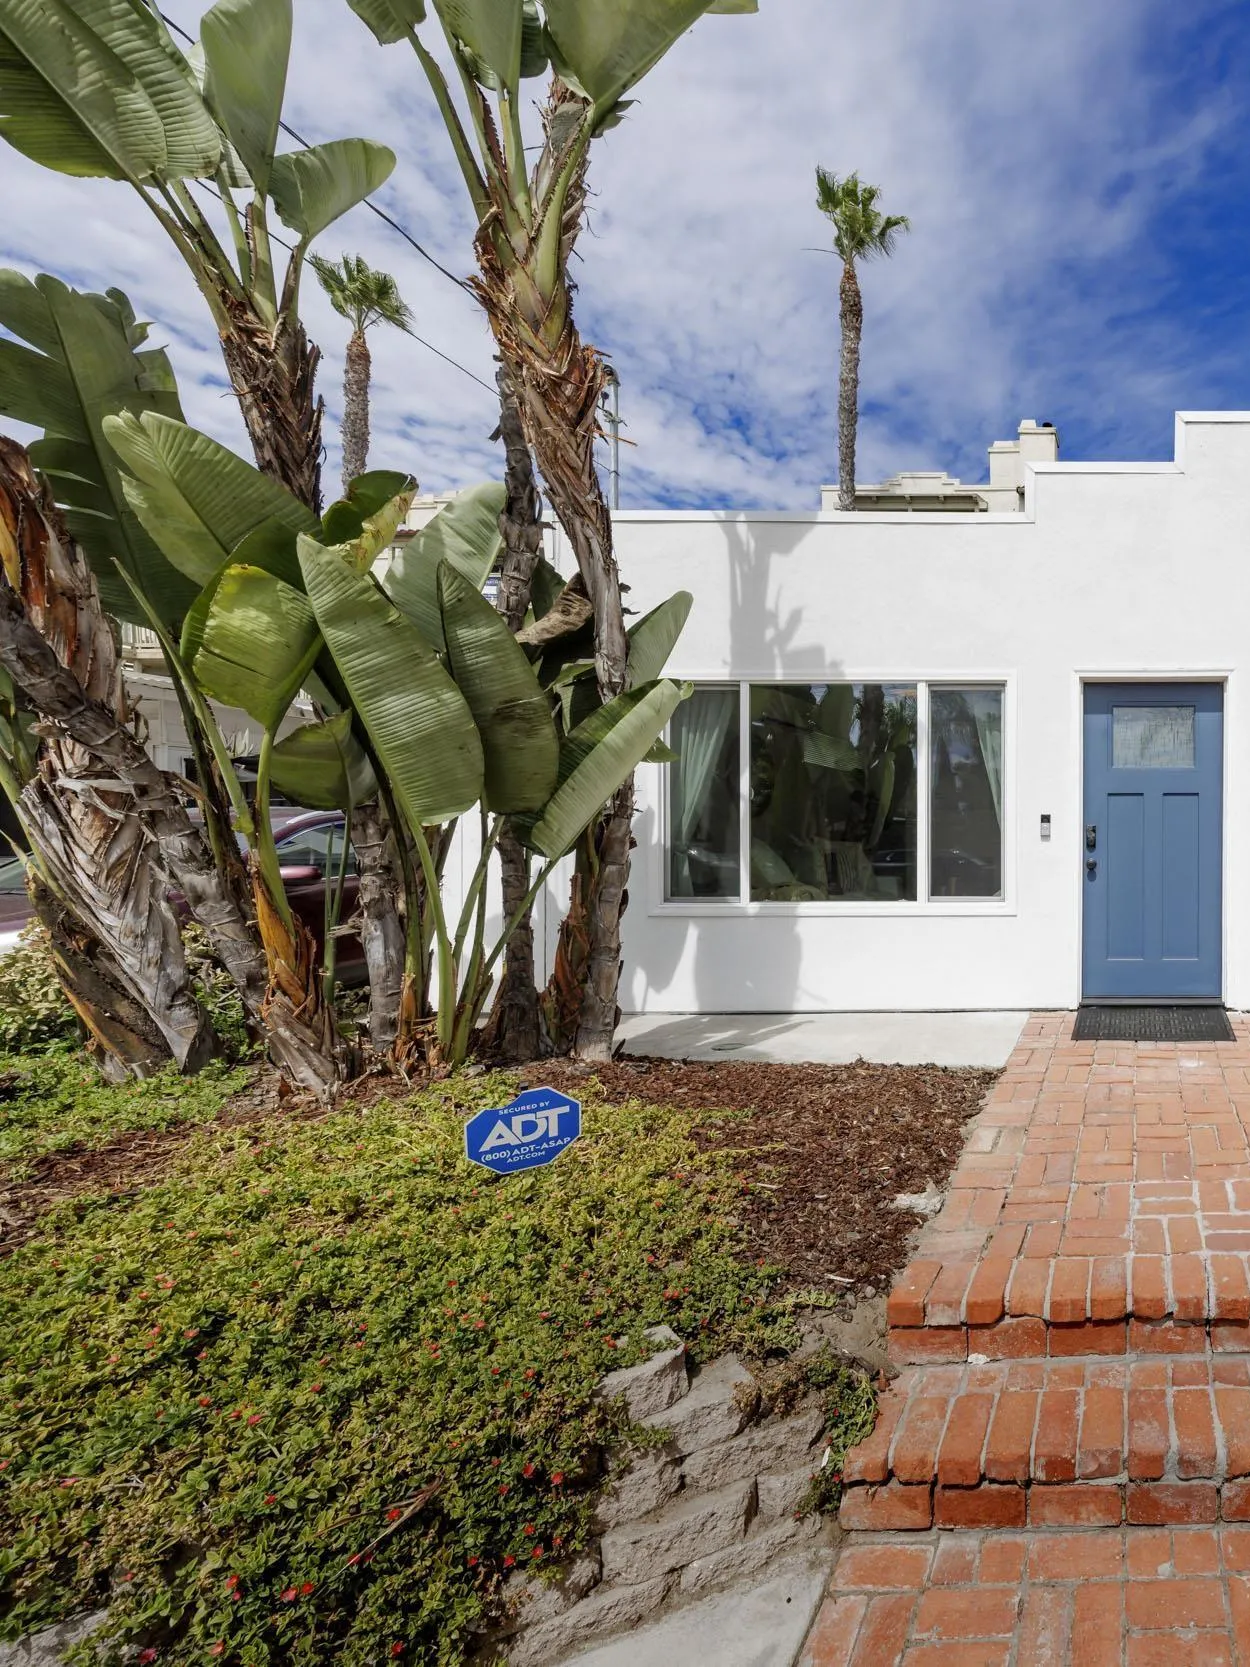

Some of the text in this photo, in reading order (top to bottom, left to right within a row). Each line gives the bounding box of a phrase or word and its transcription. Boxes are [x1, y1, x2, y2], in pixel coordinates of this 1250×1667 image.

[498, 1100, 550, 1115] SECURED BY
[479, 1105, 570, 1152] ADT
[481, 1136, 571, 1163] (800) ADT-ASAP
[506, 1151, 546, 1163] ADT.COM
